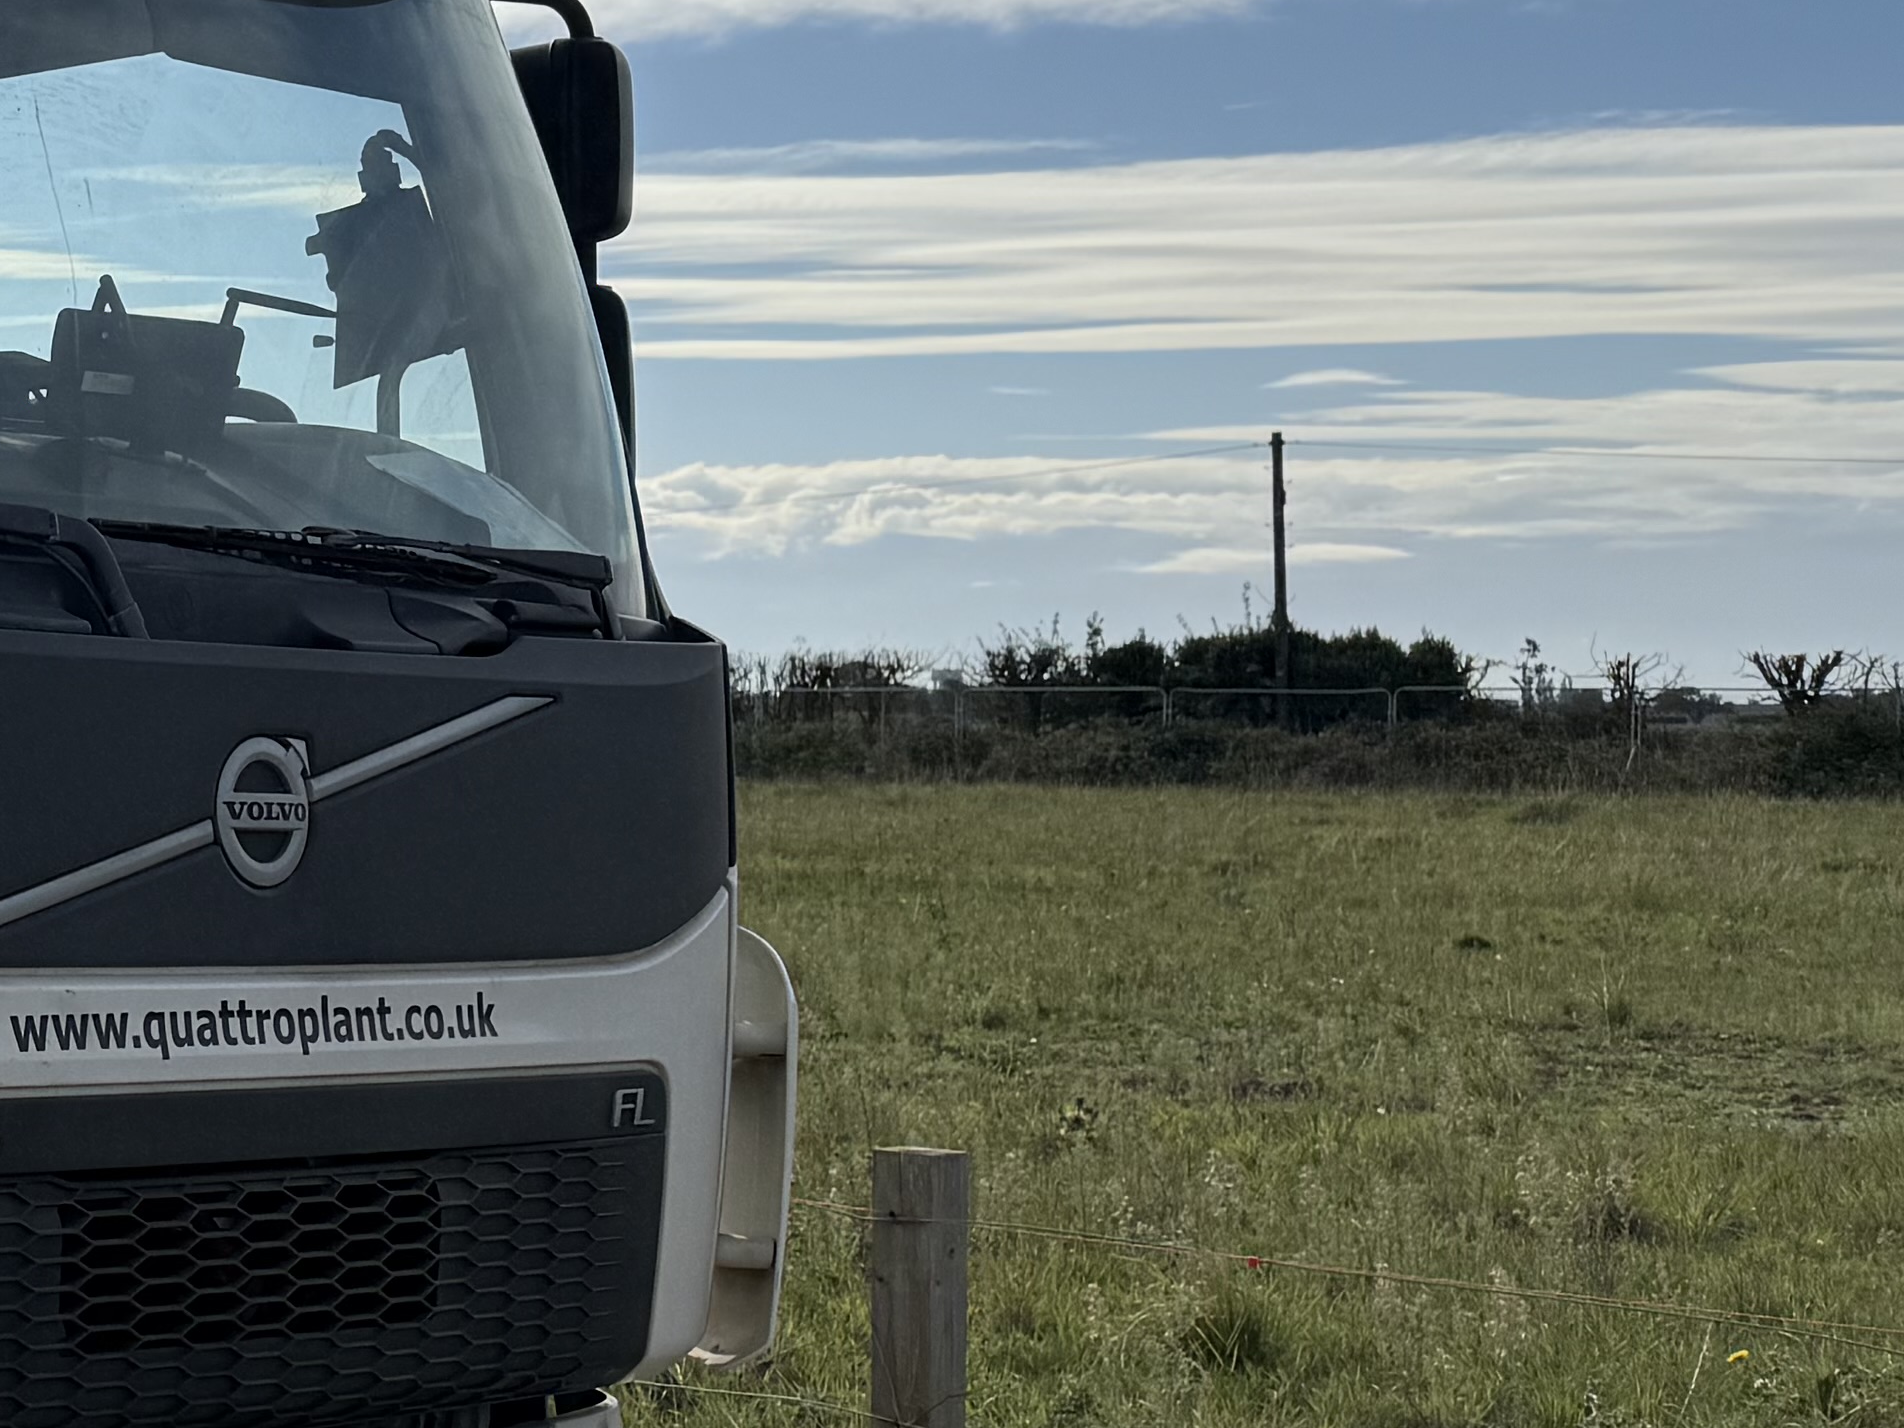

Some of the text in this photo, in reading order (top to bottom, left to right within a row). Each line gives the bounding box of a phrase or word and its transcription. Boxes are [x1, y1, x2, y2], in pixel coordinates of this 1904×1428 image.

[222, 800, 307, 822] VOLVO
[9, 992, 498, 1056] www.quattroplant.co.uk
[613, 1087, 655, 1127] FL
